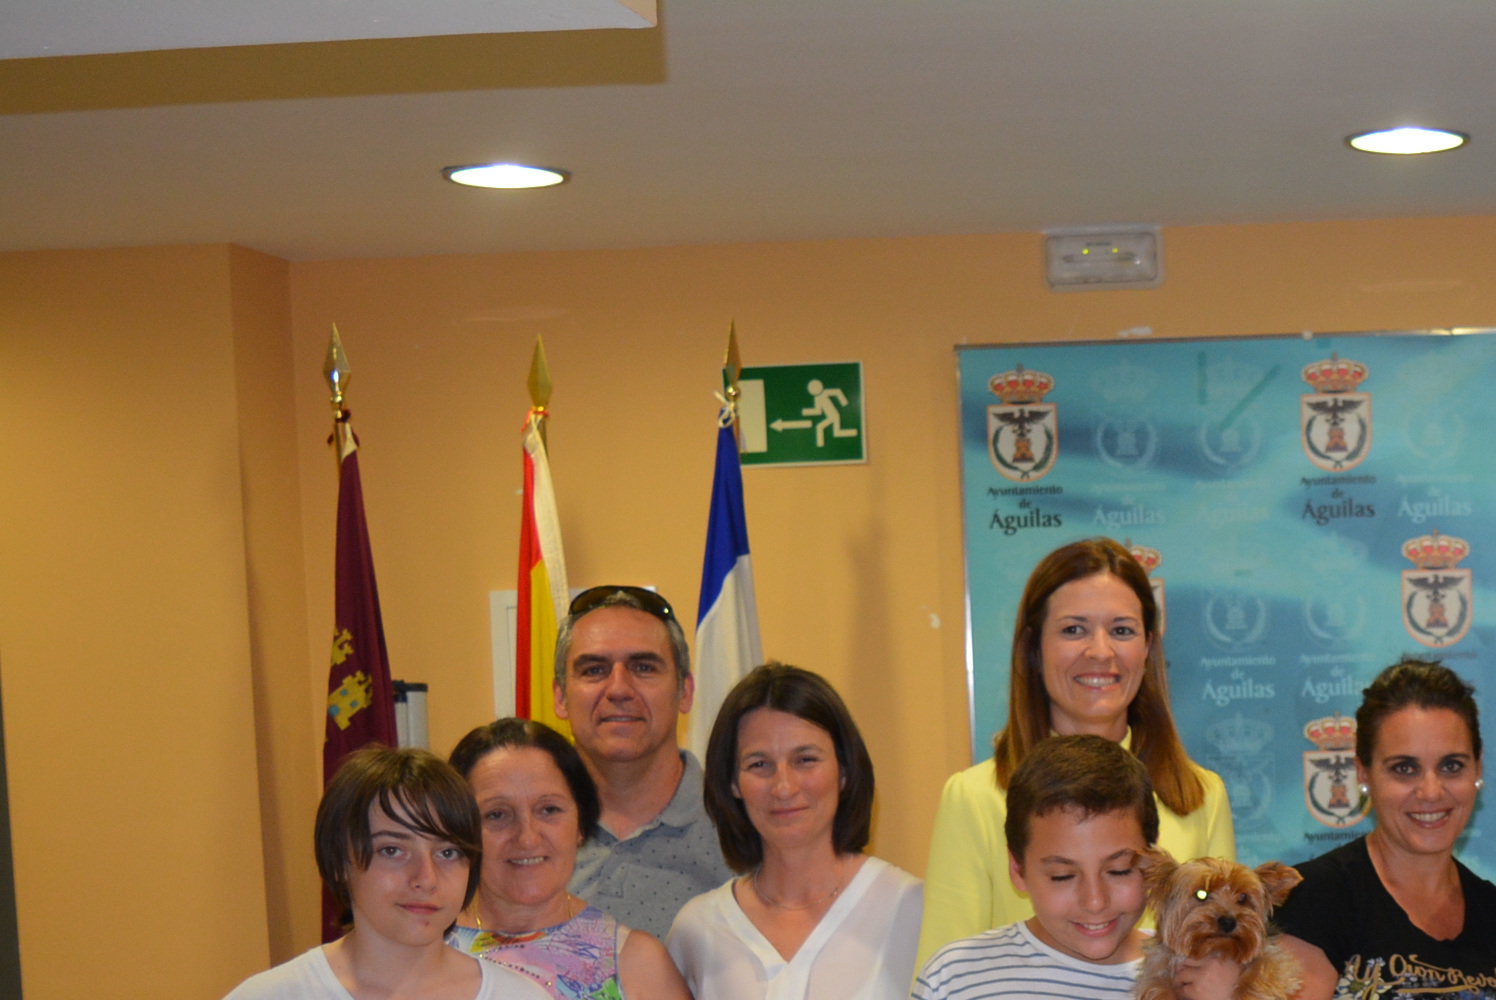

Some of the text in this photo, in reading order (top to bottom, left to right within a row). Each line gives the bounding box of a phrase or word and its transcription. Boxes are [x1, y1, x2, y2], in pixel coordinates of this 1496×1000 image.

[987, 485, 1063, 499] Ayuntamiento
[1300, 475, 1376, 489] Ayuntamiento
[1018, 497, 1032, 509] de
[1331, 487, 1345, 499] de
[1092, 507, 1167, 533] Águilas
[1301, 500, 1376, 526] Águilas
[1398, 497, 1473, 523] Águilas
[988, 510, 1063, 536] Águilas
[1201, 655, 1277, 669] Ayuntamiento
[1232, 667, 1246, 679] de
[1202, 679, 1277, 705] Águilas
[1389, 954, 1446, 983] Own
